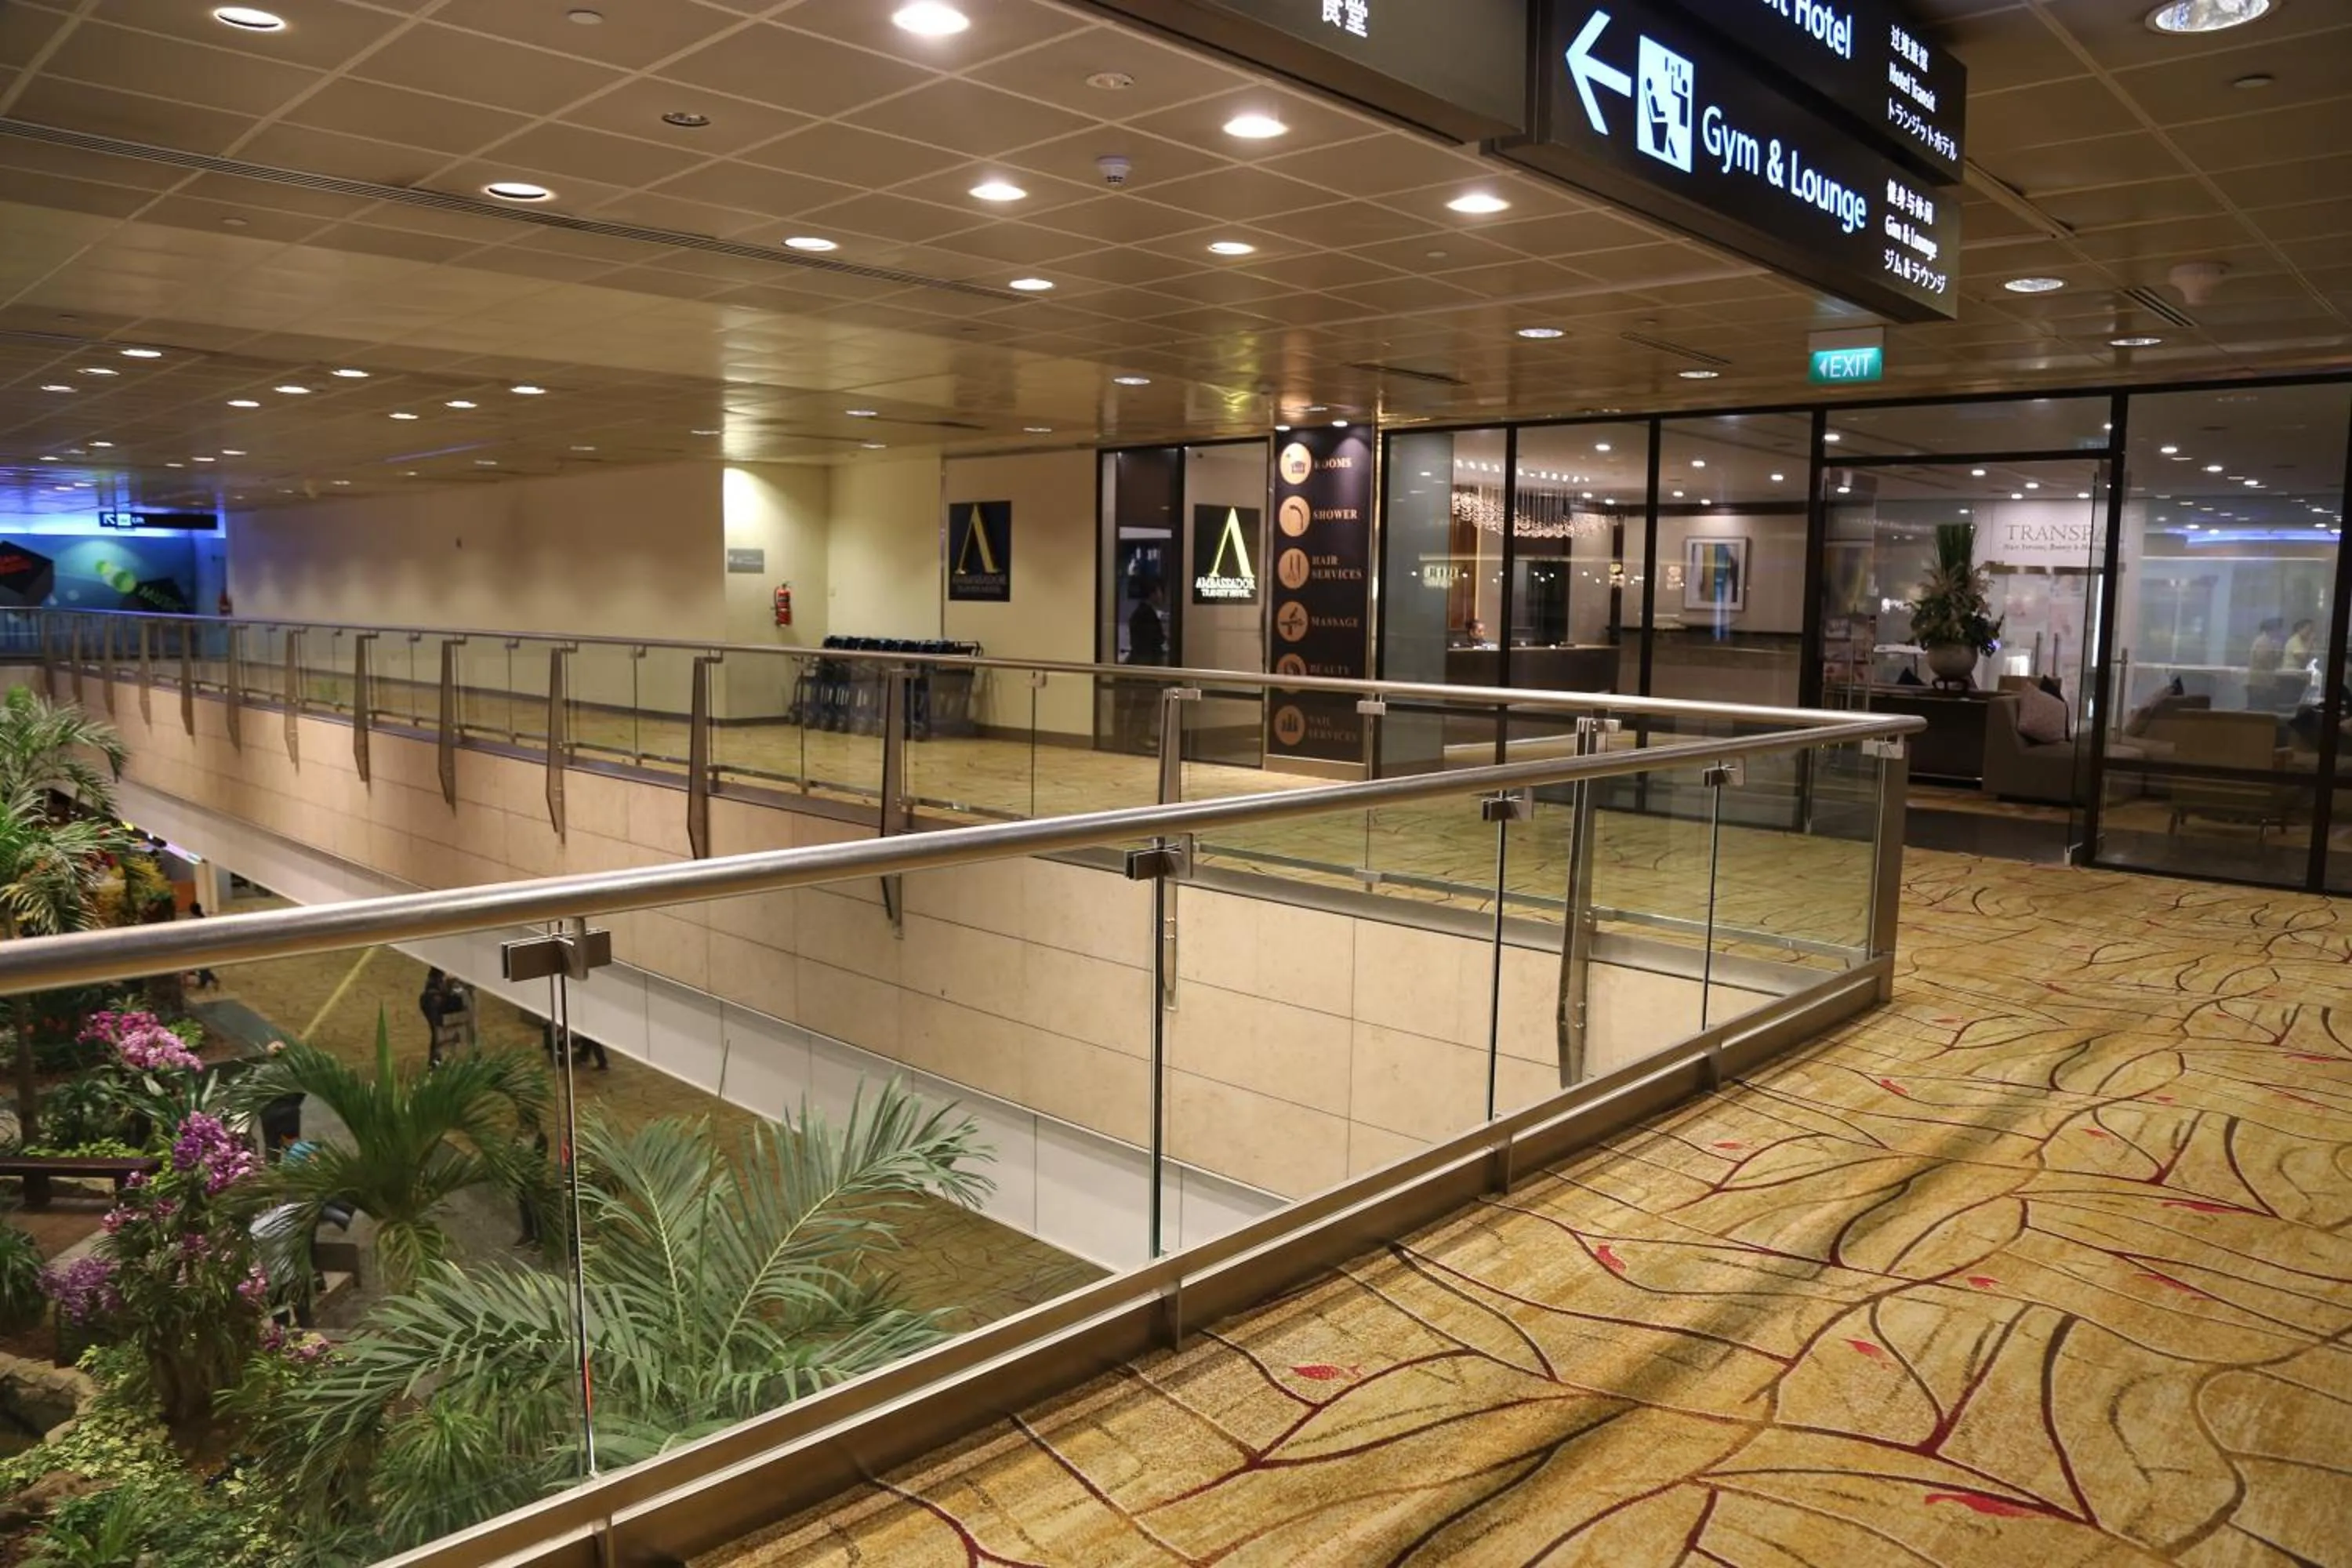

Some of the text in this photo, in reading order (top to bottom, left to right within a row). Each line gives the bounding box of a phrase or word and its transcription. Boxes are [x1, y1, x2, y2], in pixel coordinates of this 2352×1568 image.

[1795, 0, 1852, 60] Hotel
[1702, 106, 1867, 233] Gym & Lounge
[1830, 352, 1872, 378] EXIT
[1314, 457, 1352, 469] ROOMS
[1313, 509, 1358, 520] SHOWER
[1312, 555, 1338, 565] HAIR
[1312, 568, 1362, 580] SERVICES
[1311, 616, 1359, 627] MASSAGE
